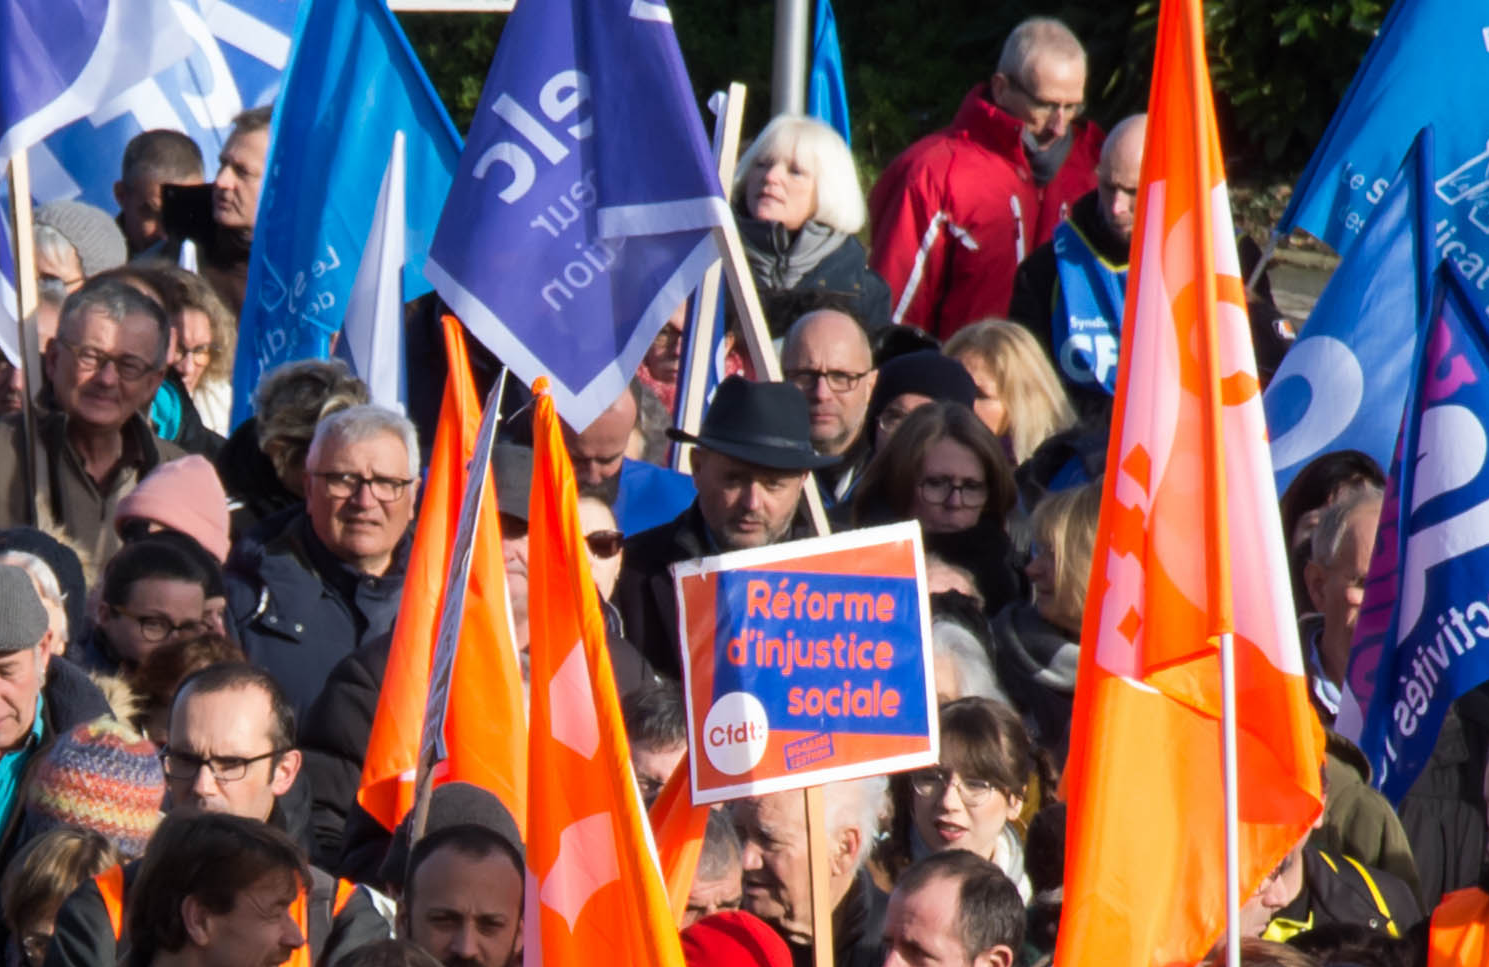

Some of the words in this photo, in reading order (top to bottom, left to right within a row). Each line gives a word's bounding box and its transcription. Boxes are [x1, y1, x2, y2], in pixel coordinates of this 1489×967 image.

[746, 577, 896, 622] Réforme
[727, 628, 895, 676] d'injustice
[787, 680, 902, 718] sociale
[710, 720, 764, 747] Cfdt:
